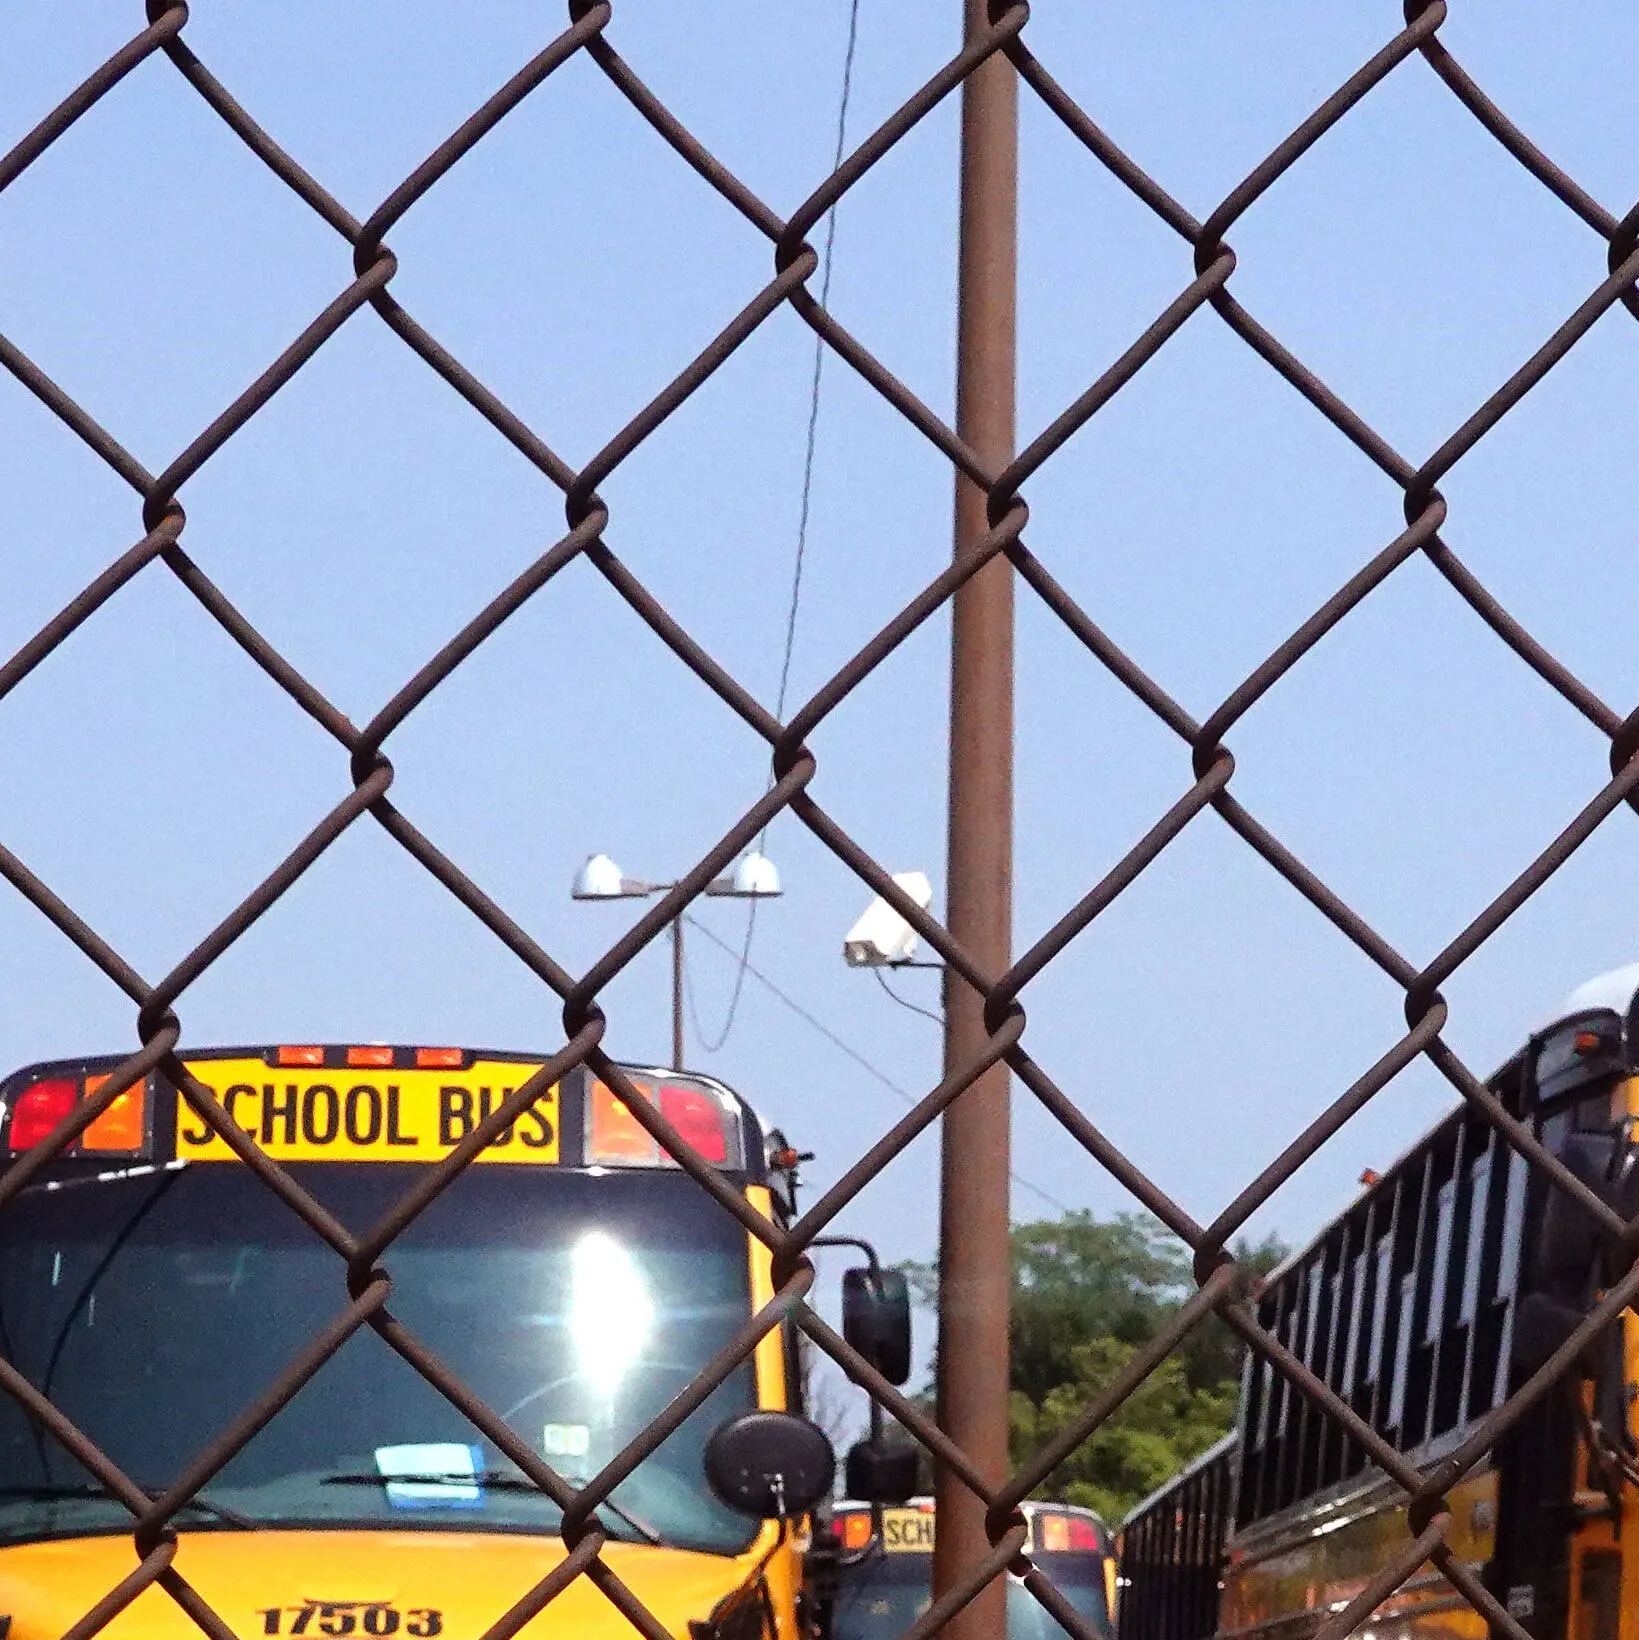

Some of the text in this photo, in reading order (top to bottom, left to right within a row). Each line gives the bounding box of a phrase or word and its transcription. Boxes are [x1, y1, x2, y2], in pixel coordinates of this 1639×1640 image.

[182, 1084, 554, 1148] SCHOOL BUS
[886, 1519, 934, 1545] SCH
[255, 1600, 443, 1637] 17503
